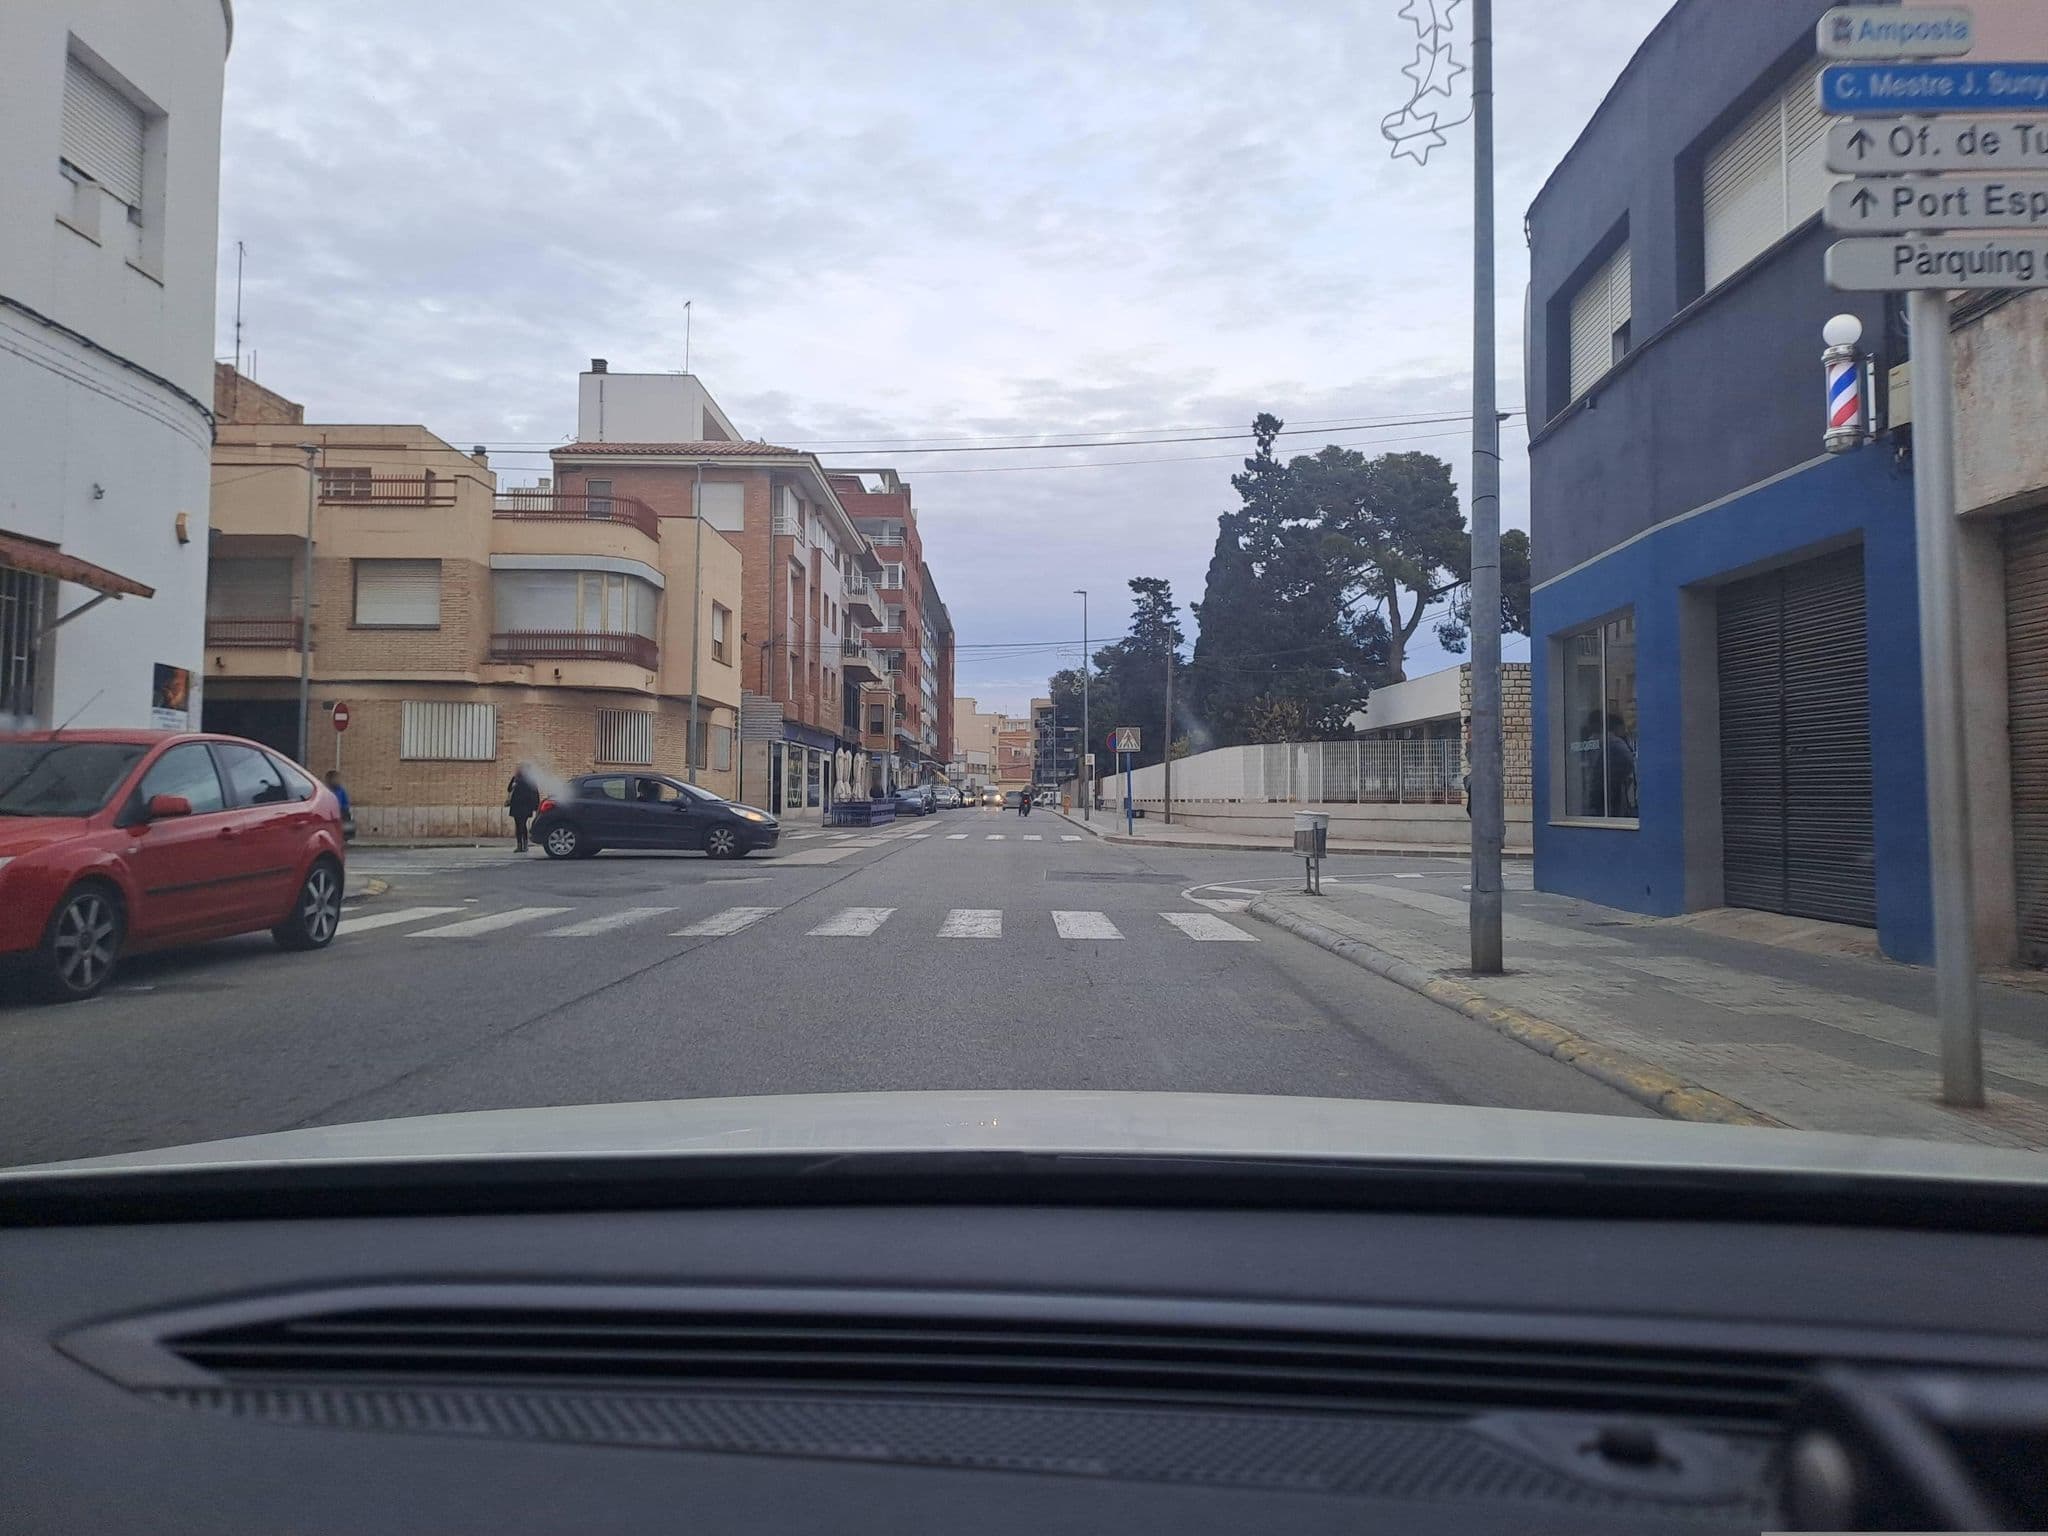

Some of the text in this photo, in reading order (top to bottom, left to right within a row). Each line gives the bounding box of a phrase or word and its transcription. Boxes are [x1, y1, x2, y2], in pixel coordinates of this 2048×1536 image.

[1858, 17, 1968, 45] Amposta
[1836, 73, 1862, 98] C.
[1870, 73, 1953, 97] Mestre
[1958, 71, 1981, 96] J.
[1888, 124, 2048, 157] Of. de Tu
[1893, 184, 2048, 222] Port Esp
